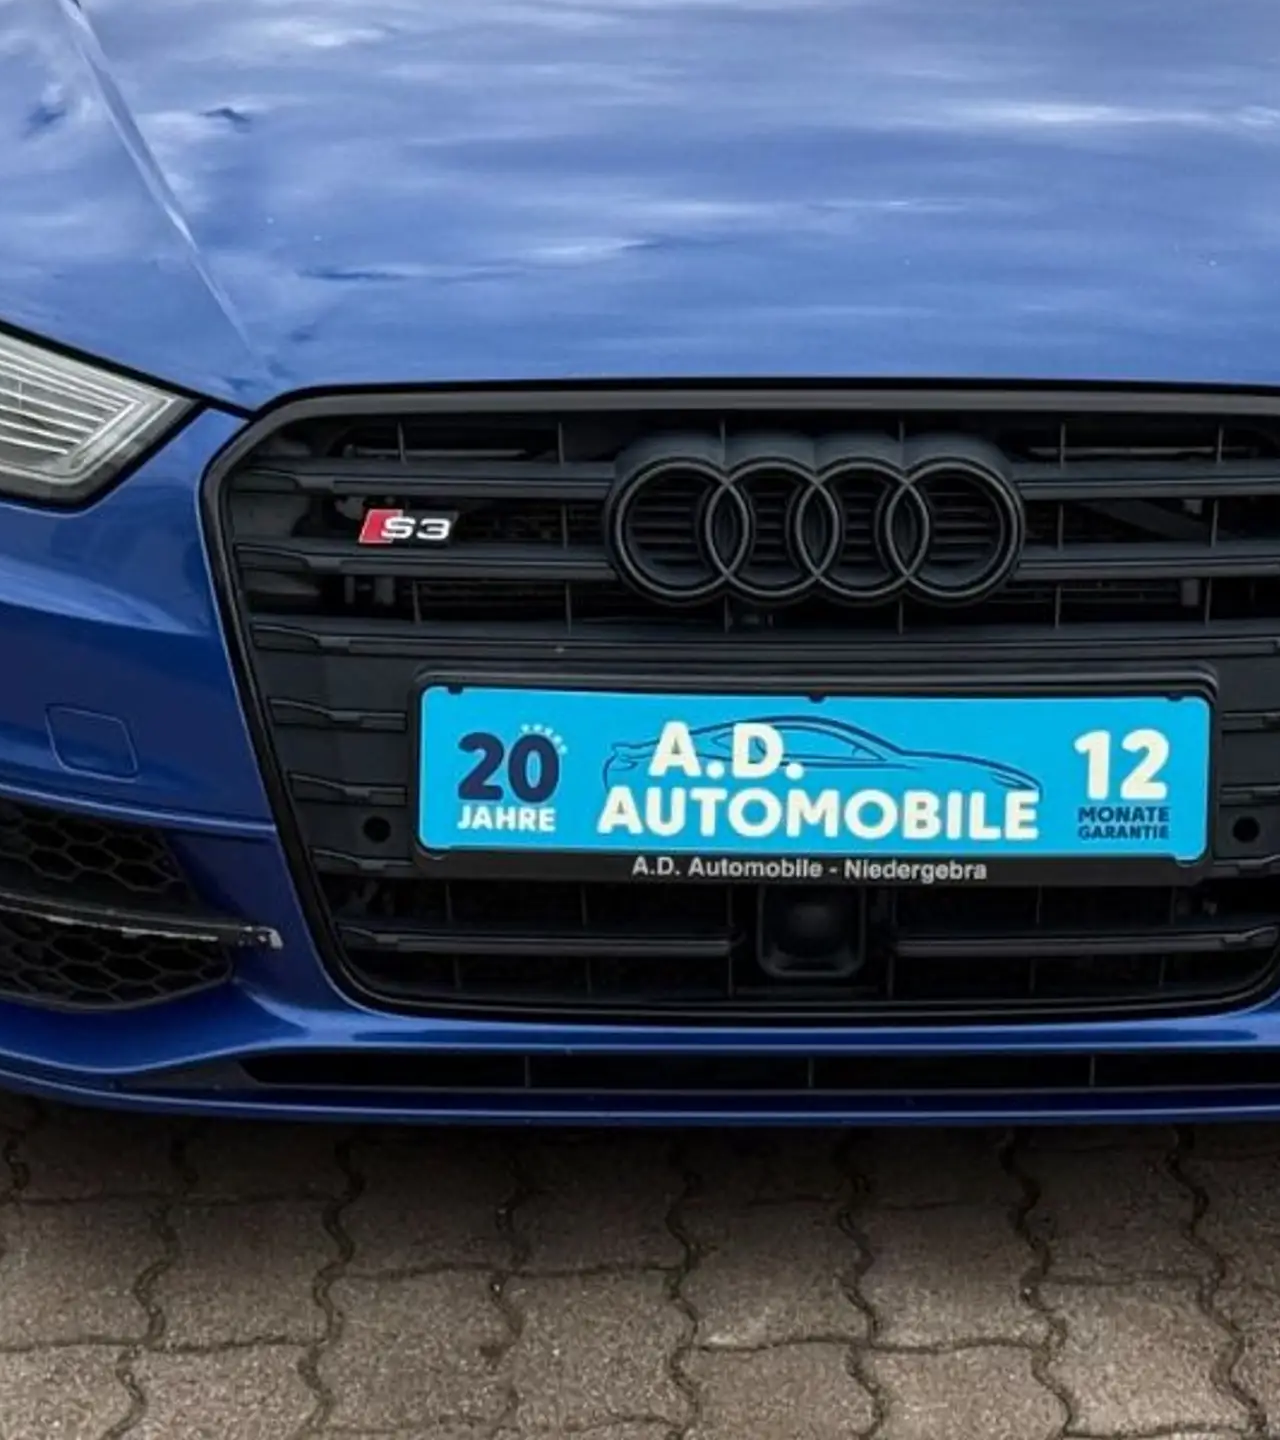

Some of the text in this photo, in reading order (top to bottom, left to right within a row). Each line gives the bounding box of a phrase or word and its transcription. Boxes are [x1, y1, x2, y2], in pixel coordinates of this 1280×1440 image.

[380, 516, 452, 540] S3
[648, 720, 805, 780] A.D.
[457, 731, 560, 804] 20
[1074, 728, 1170, 801] 12
[456, 804, 557, 832] JAHRE
[596, 785, 1040, 841] AUTOMOBILE
[1077, 805, 1171, 823] MONATE
[1077, 824, 1170, 841] GARANTIE
[631, 856, 681, 877] A.D.
[688, 857, 823, 879] Automobile
[844, 859, 988, 884] Niedergebra
